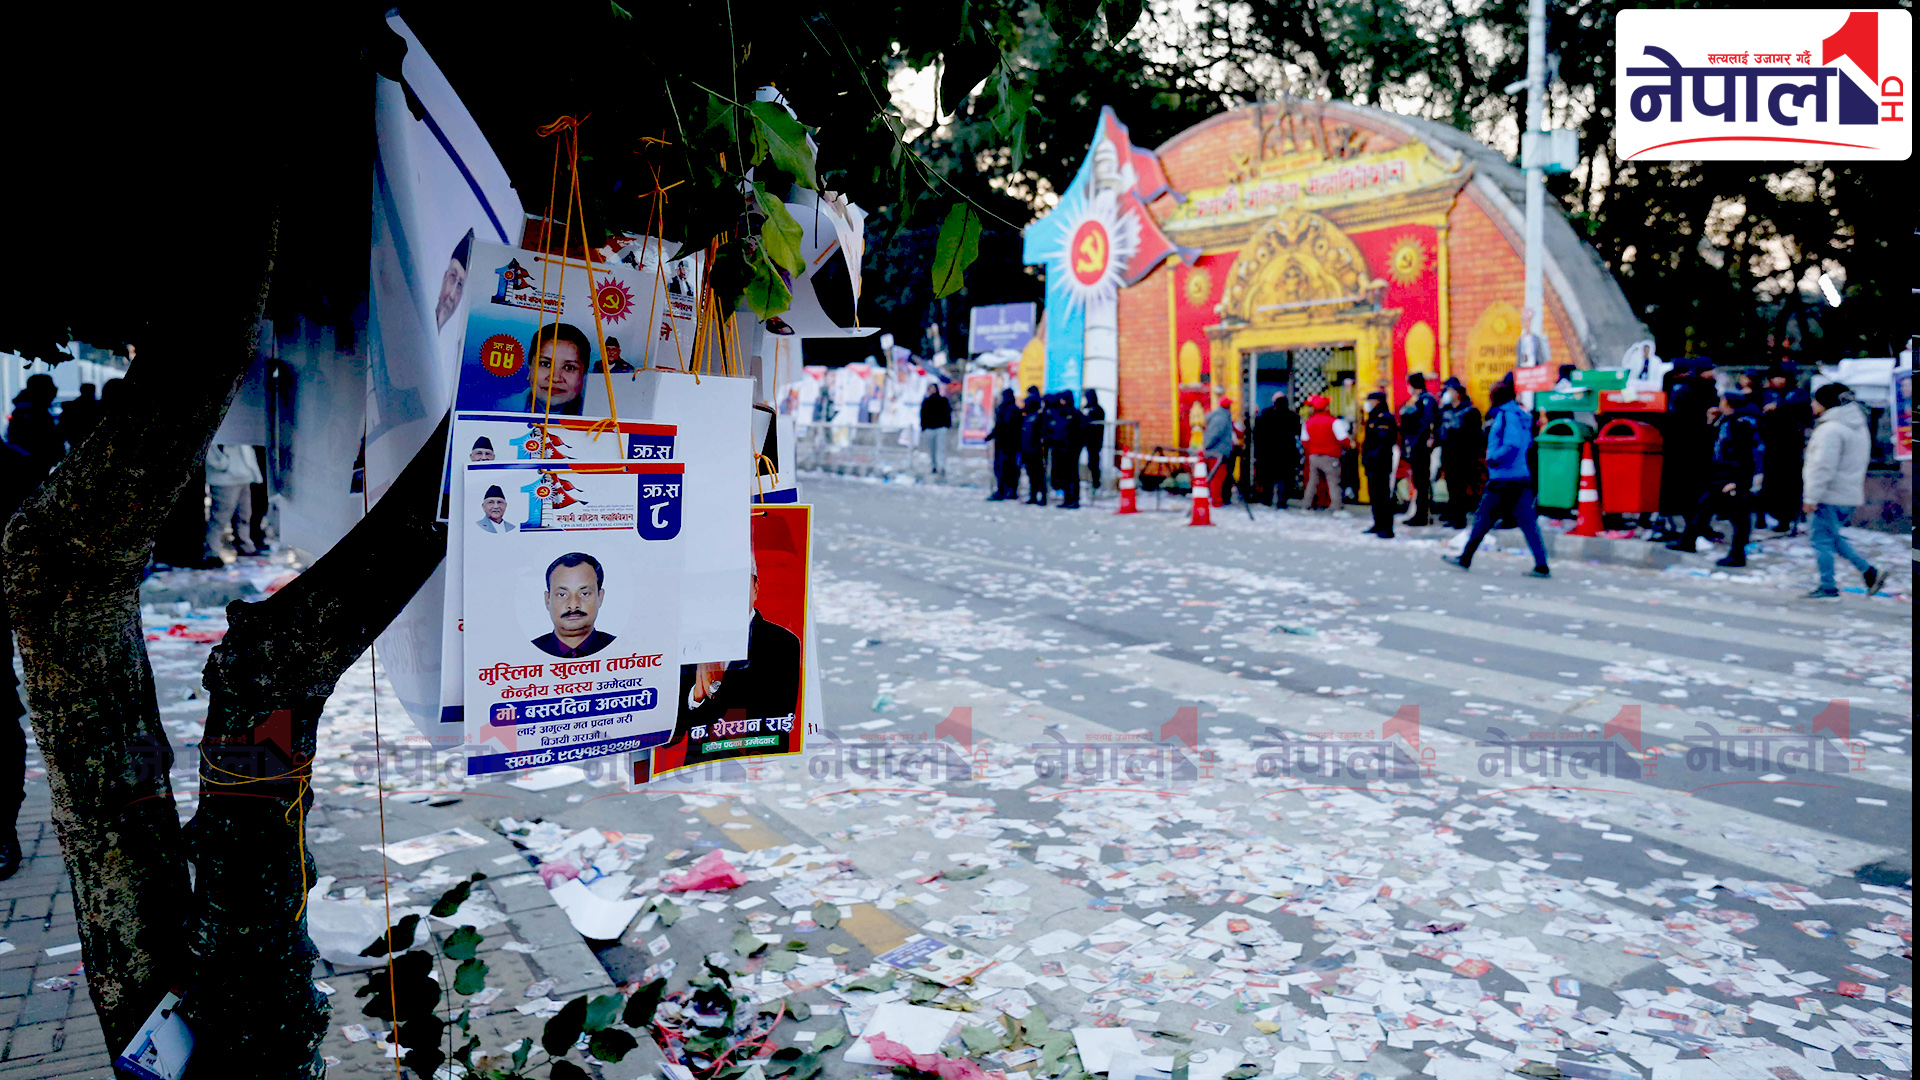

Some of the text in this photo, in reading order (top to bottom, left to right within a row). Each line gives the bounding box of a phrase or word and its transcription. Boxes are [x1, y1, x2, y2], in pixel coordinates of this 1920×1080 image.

[642, 483, 681, 499] क्र.स
[478, 653, 664, 685] मुस्लिम खुल्ला तर्फबाट
[501, 677, 643, 699] केन्द्रीय सदस्य उम्मेदवार
[525, 697, 592, 719] बसरदिन
[595, 690, 653, 711] अन्सारी
[517, 713, 634, 737] लाई अमुल्य मत प्रदान गरी
[712, 717, 763, 737] शेरधन
[765, 712, 797, 733] राई
[540, 733, 570, 747] विजयी
[705, 741, 723, 752] सचिव
[743, 736, 776, 747] उम्मेदवार
